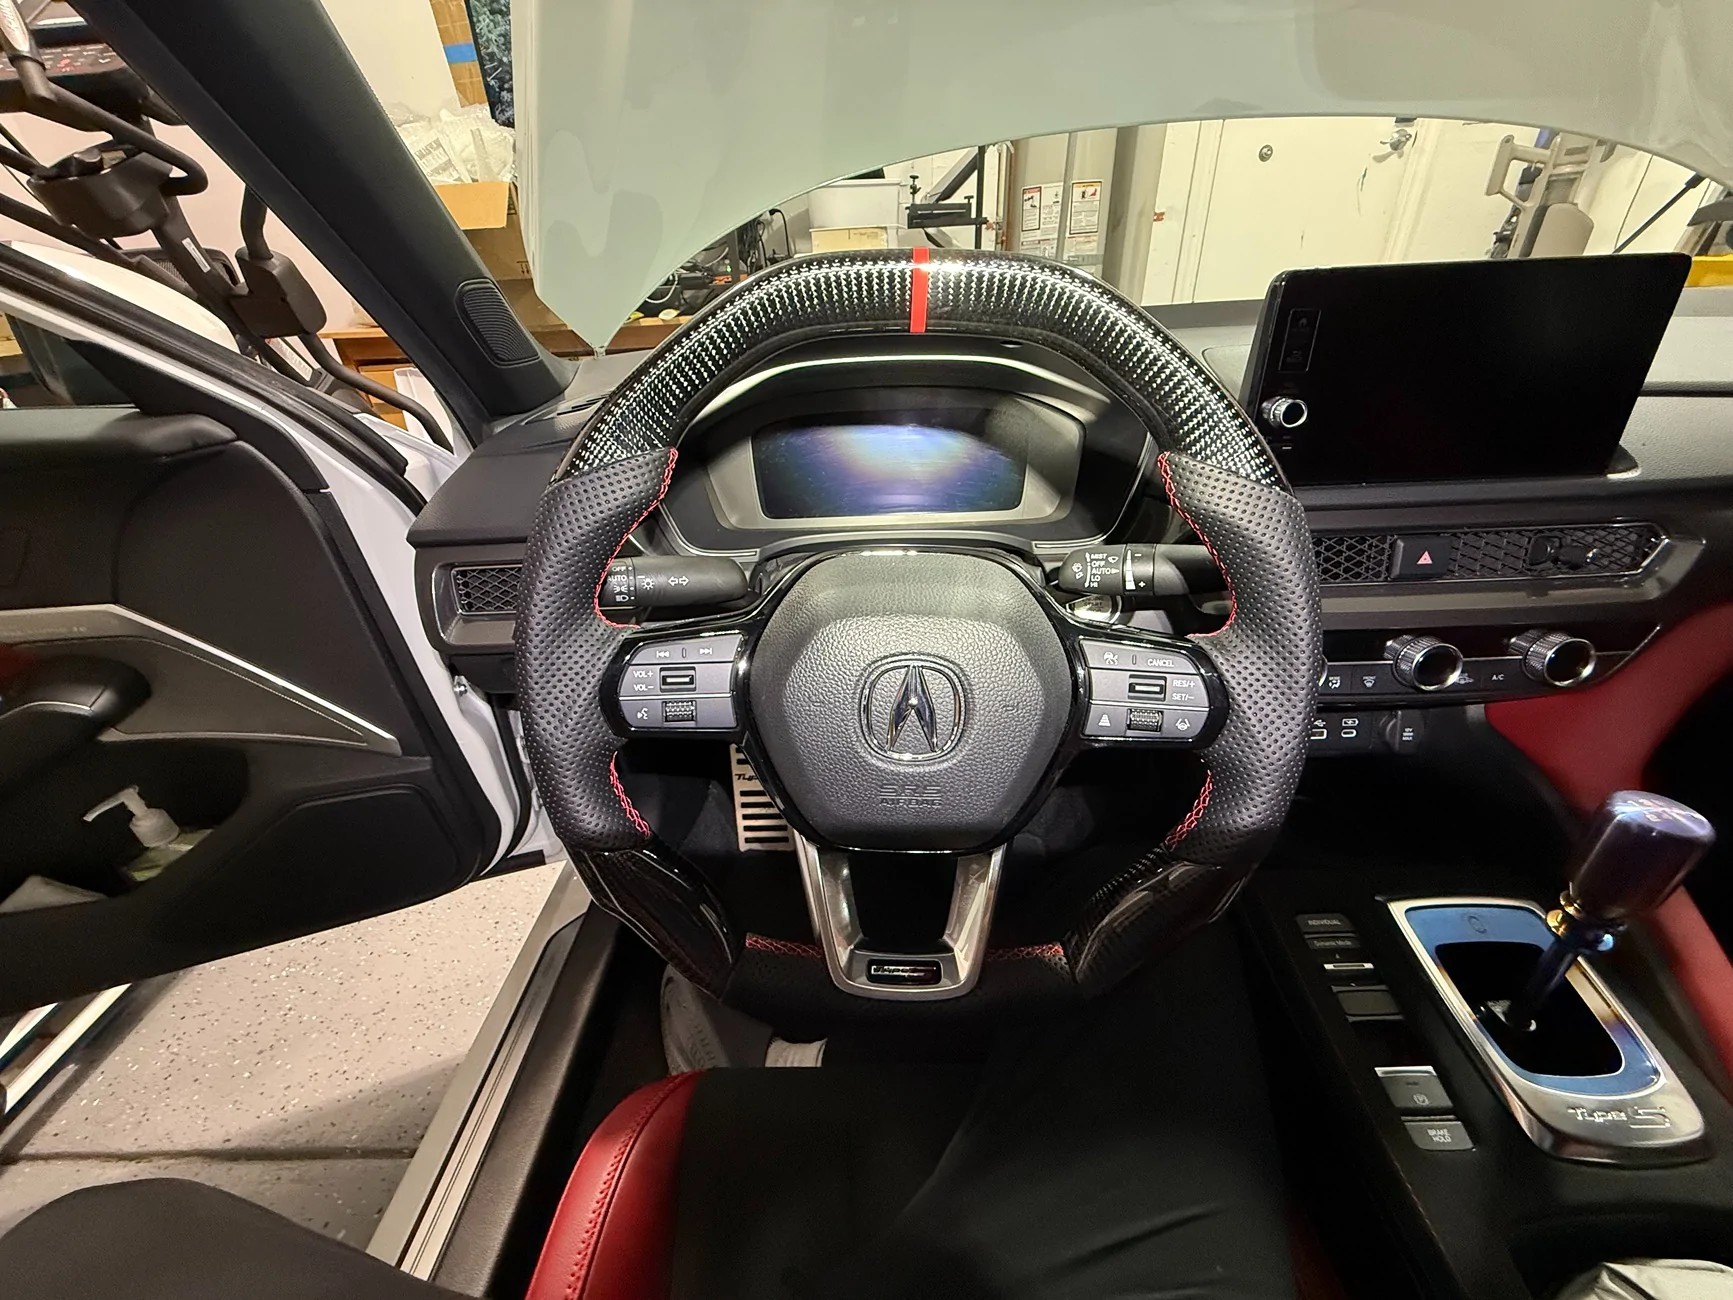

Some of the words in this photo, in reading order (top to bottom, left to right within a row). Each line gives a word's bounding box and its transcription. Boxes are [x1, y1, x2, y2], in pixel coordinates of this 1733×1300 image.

[1147, 658, 1174, 667] CANCEL
[1427, 1128, 1450, 1136] BRAKE
[1431, 1135, 1452, 1143] HOLD
